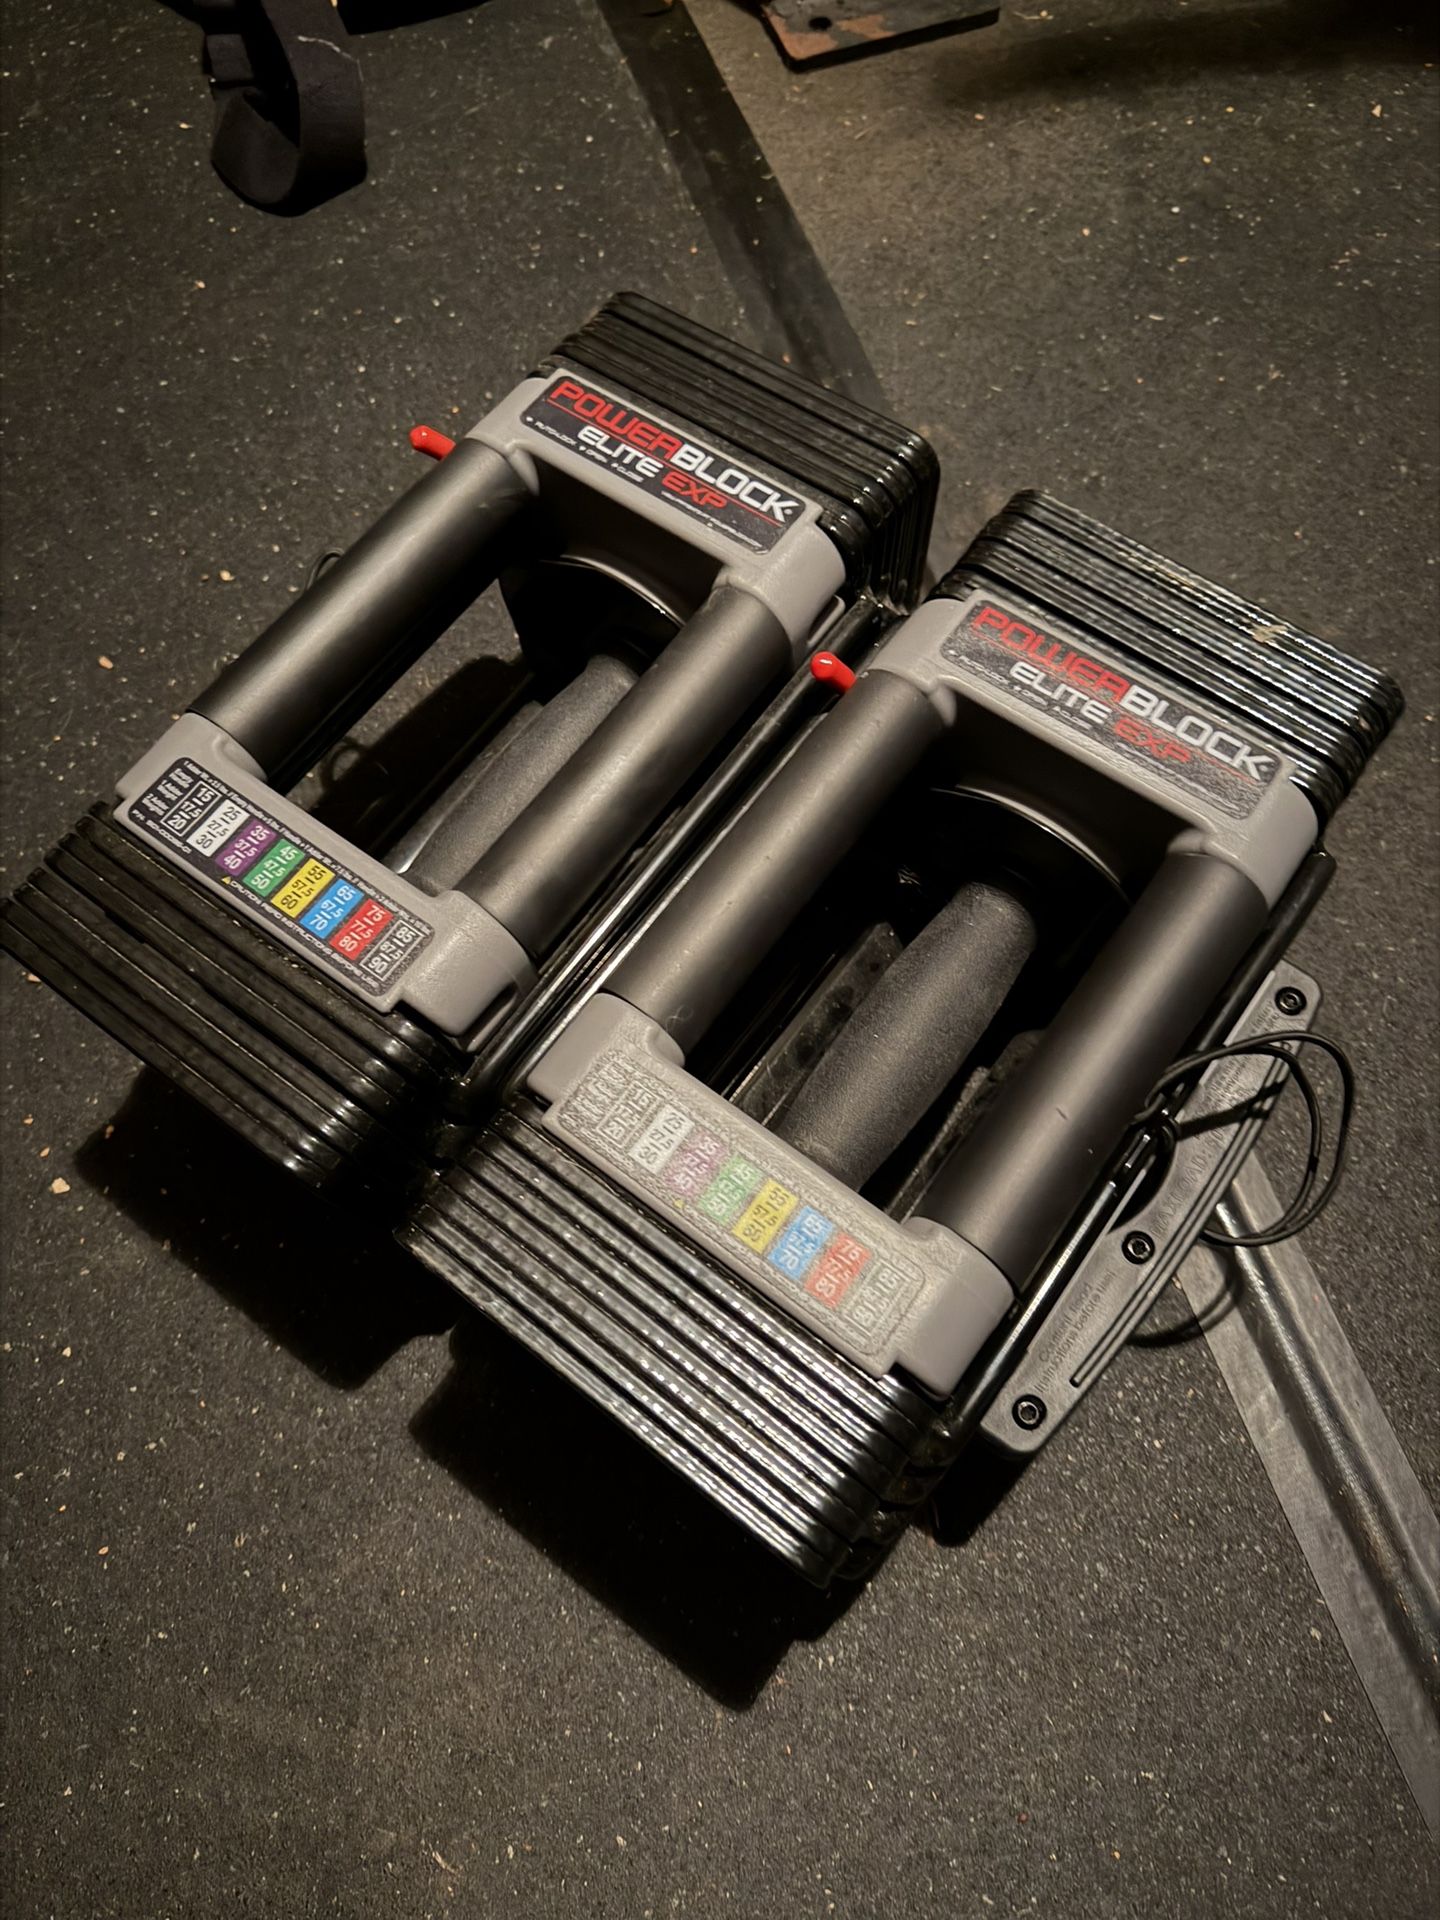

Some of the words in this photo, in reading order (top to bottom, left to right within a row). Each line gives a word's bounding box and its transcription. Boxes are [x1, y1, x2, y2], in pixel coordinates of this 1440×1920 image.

[549, 378, 798, 523] POWERBLOCK
[576, 423, 663, 479] ELITE
[659, 468, 729, 514] EXP
[970, 604, 1274, 783] POWERBLOCK
[1007, 658, 1112, 725] ELITE
[1109, 715, 1193, 771] EXP
[166, 813, 187, 831] 20
[194, 832, 214, 850] 30
[221, 851, 243, 870] 40
[249, 872, 271, 890] 50
[279, 892, 299, 910] 60
[307, 913, 329, 932] 70
[337, 934, 359, 953] 80
[367, 955, 389, 975] 90
[179, 799, 203, 818] 17.5
[206, 818, 229, 837] 27.5
[233, 837, 258, 858] 37.5
[261, 857, 286, 877] 47.5
[290, 878, 315, 898] 57.5
[319, 898, 344, 918] 67.5
[348, 918, 374, 939] 77.5
[378, 940, 404, 960] 87.5
[194, 785, 215, 803] 15
[221, 804, 242, 821] 25
[249, 823, 271, 842] 35
[277, 843, 298, 861] 45
[306, 863, 327, 881] 55
[335, 883, 356, 902] 65
[364, 903, 386, 923] 75
[394, 924, 416, 944] 85
[603, 1119, 626, 1141] 20
[636, 1144, 660, 1166] 30
[670, 1169, 694, 1192] 40
[776, 1248, 800, 1271] 70
[664, 1110, 686, 1131] 25
[697, 1135, 720, 1157] 35
[766, 1186, 789, 1208] 55
[751, 1203, 779, 1228] 57.5
